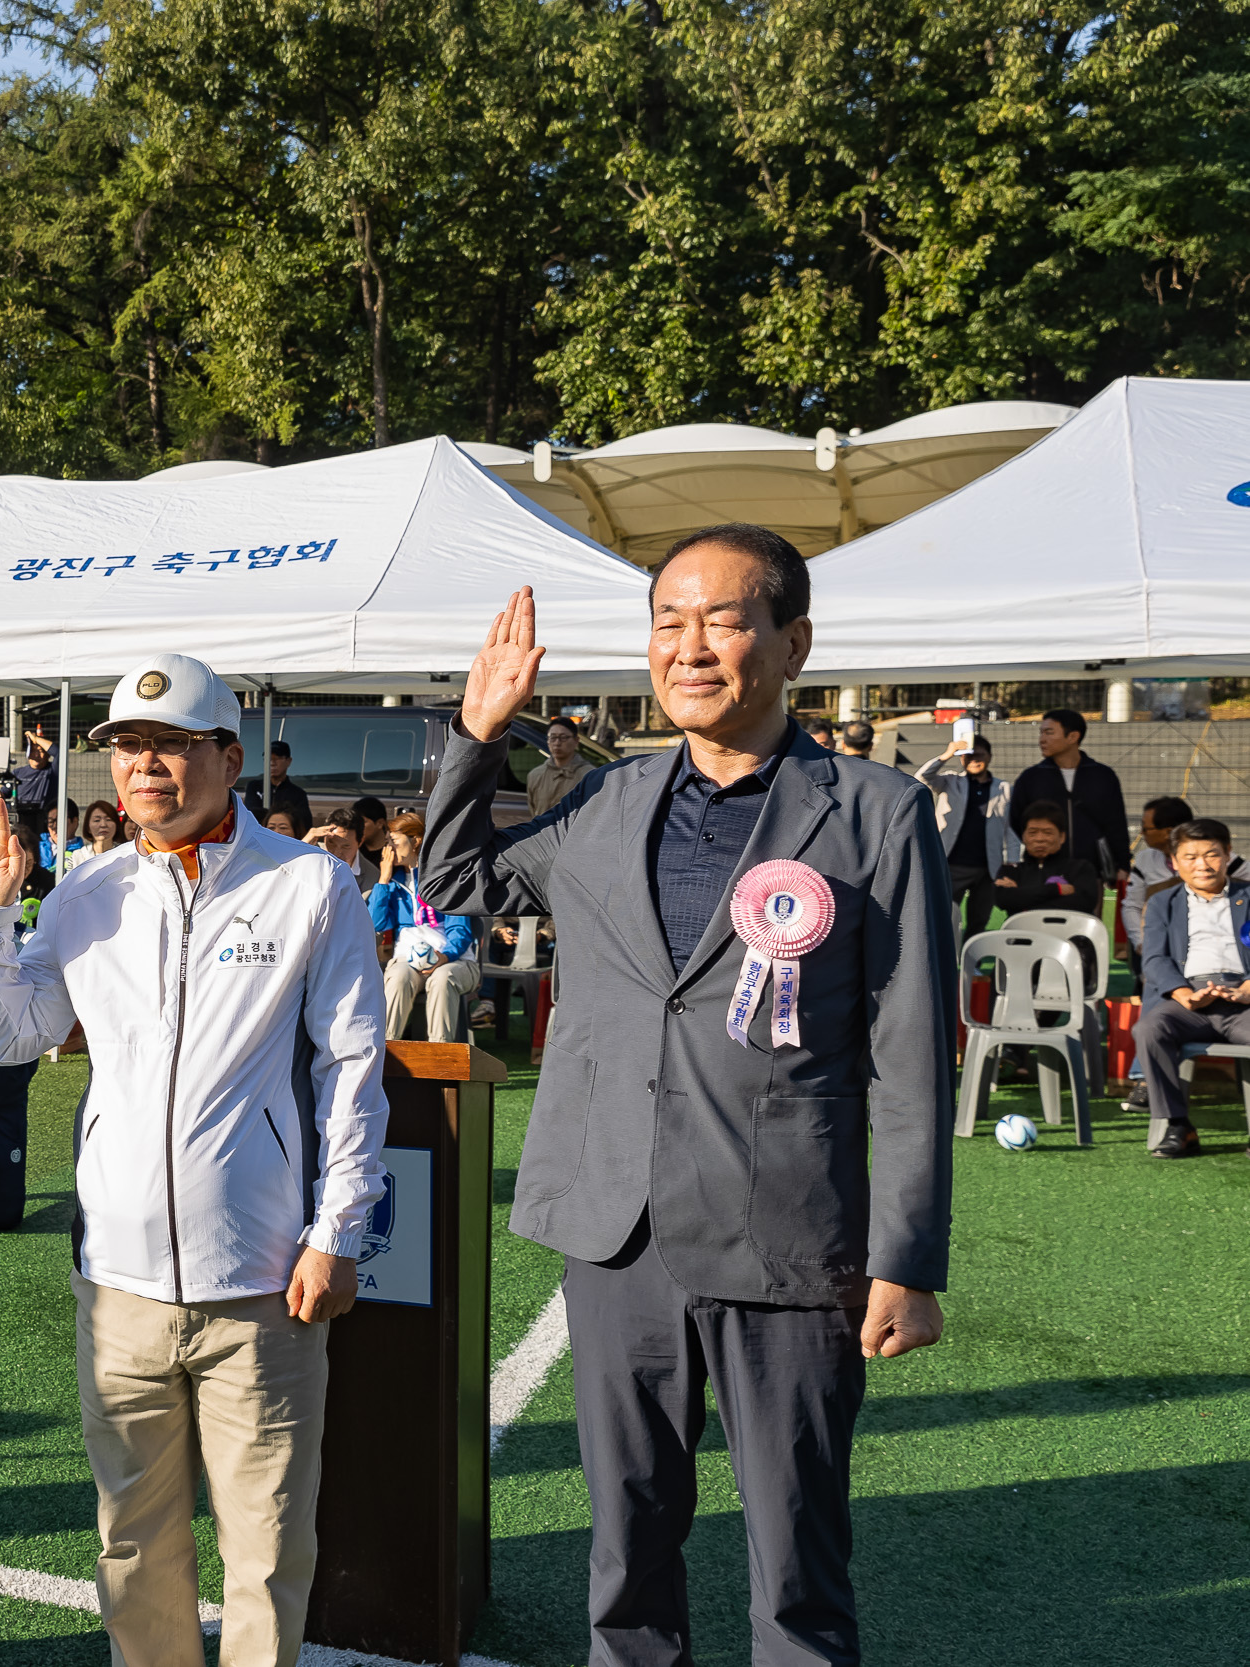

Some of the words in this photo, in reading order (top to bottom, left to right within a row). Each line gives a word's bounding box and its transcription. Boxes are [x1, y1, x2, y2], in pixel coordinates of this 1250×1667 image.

[7, 555, 137, 582] 광진구
[151, 538, 339, 576] 축구협회
[236, 954, 276, 963] 광진구청장
[732, 961, 762, 1027] 광진구축구협회
[778, 967, 794, 1034] 구체육회장
